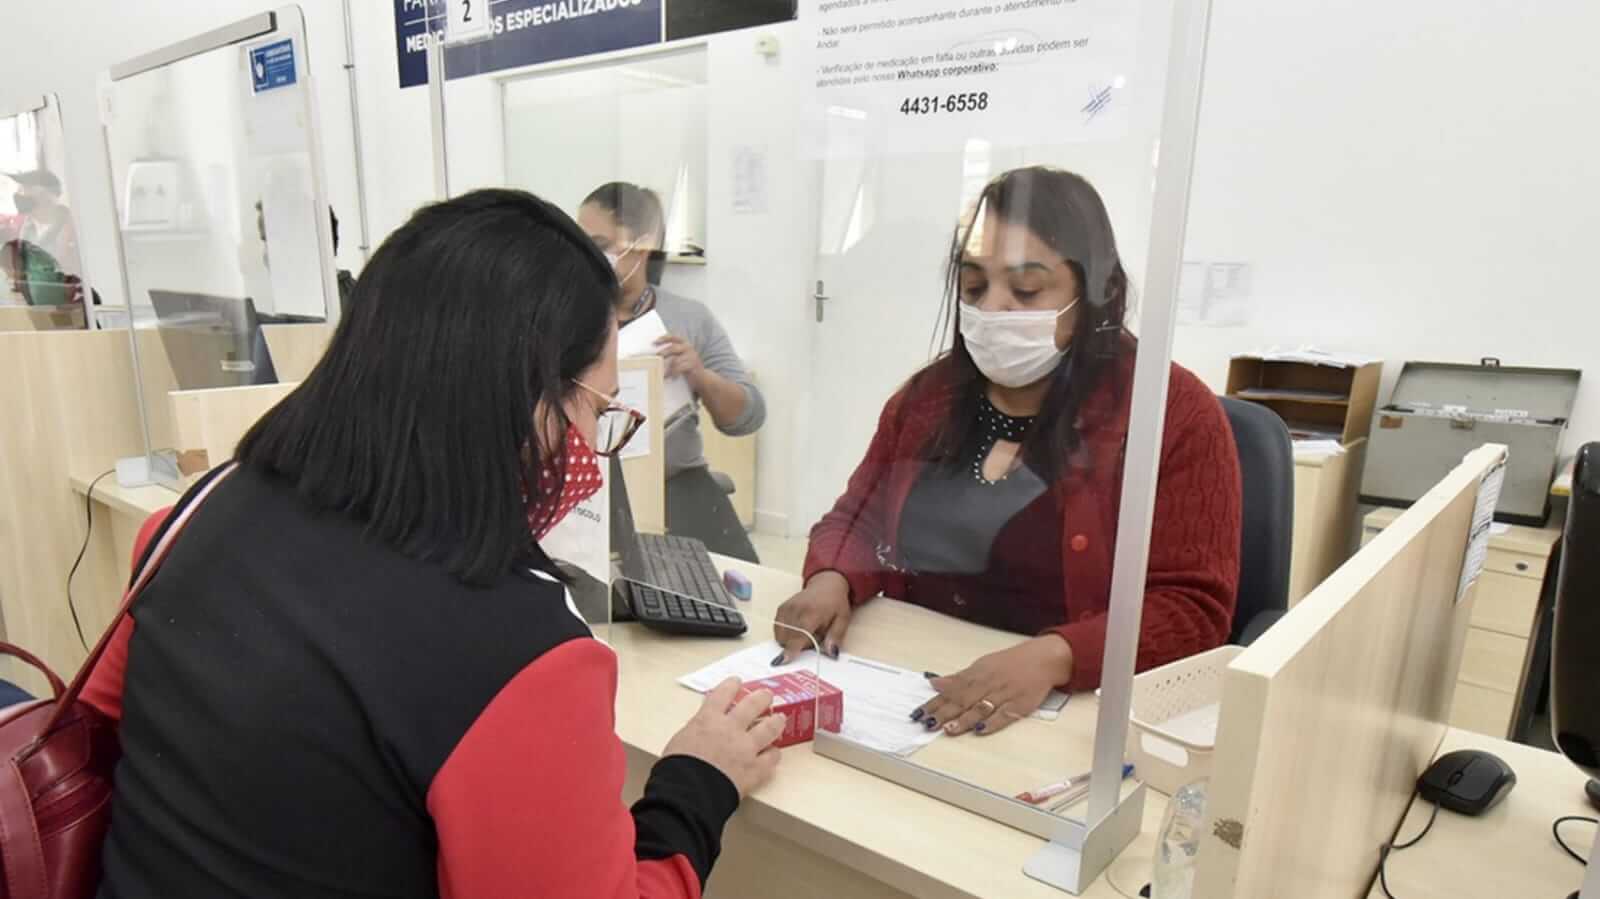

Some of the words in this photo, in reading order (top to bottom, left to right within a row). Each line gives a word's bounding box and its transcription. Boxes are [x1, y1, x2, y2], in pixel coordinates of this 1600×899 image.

[462, 0, 472, 22] 2
[506, 0, 642, 32] ESPECIALIZAD
[898, 10, 956, 27] acompanhante
[959, 5, 992, 19] durante
[921, 55, 934, 64] em
[955, 51, 967, 61] ou
[969, 48, 996, 59] outras
[1037, 40, 1071, 53] podem
[1073, 37, 1089, 48] ser
[898, 66, 941, 80] Whatsapp
[942, 63, 1000, 77] corporativo:
[900, 91, 989, 115] 4431-6558
